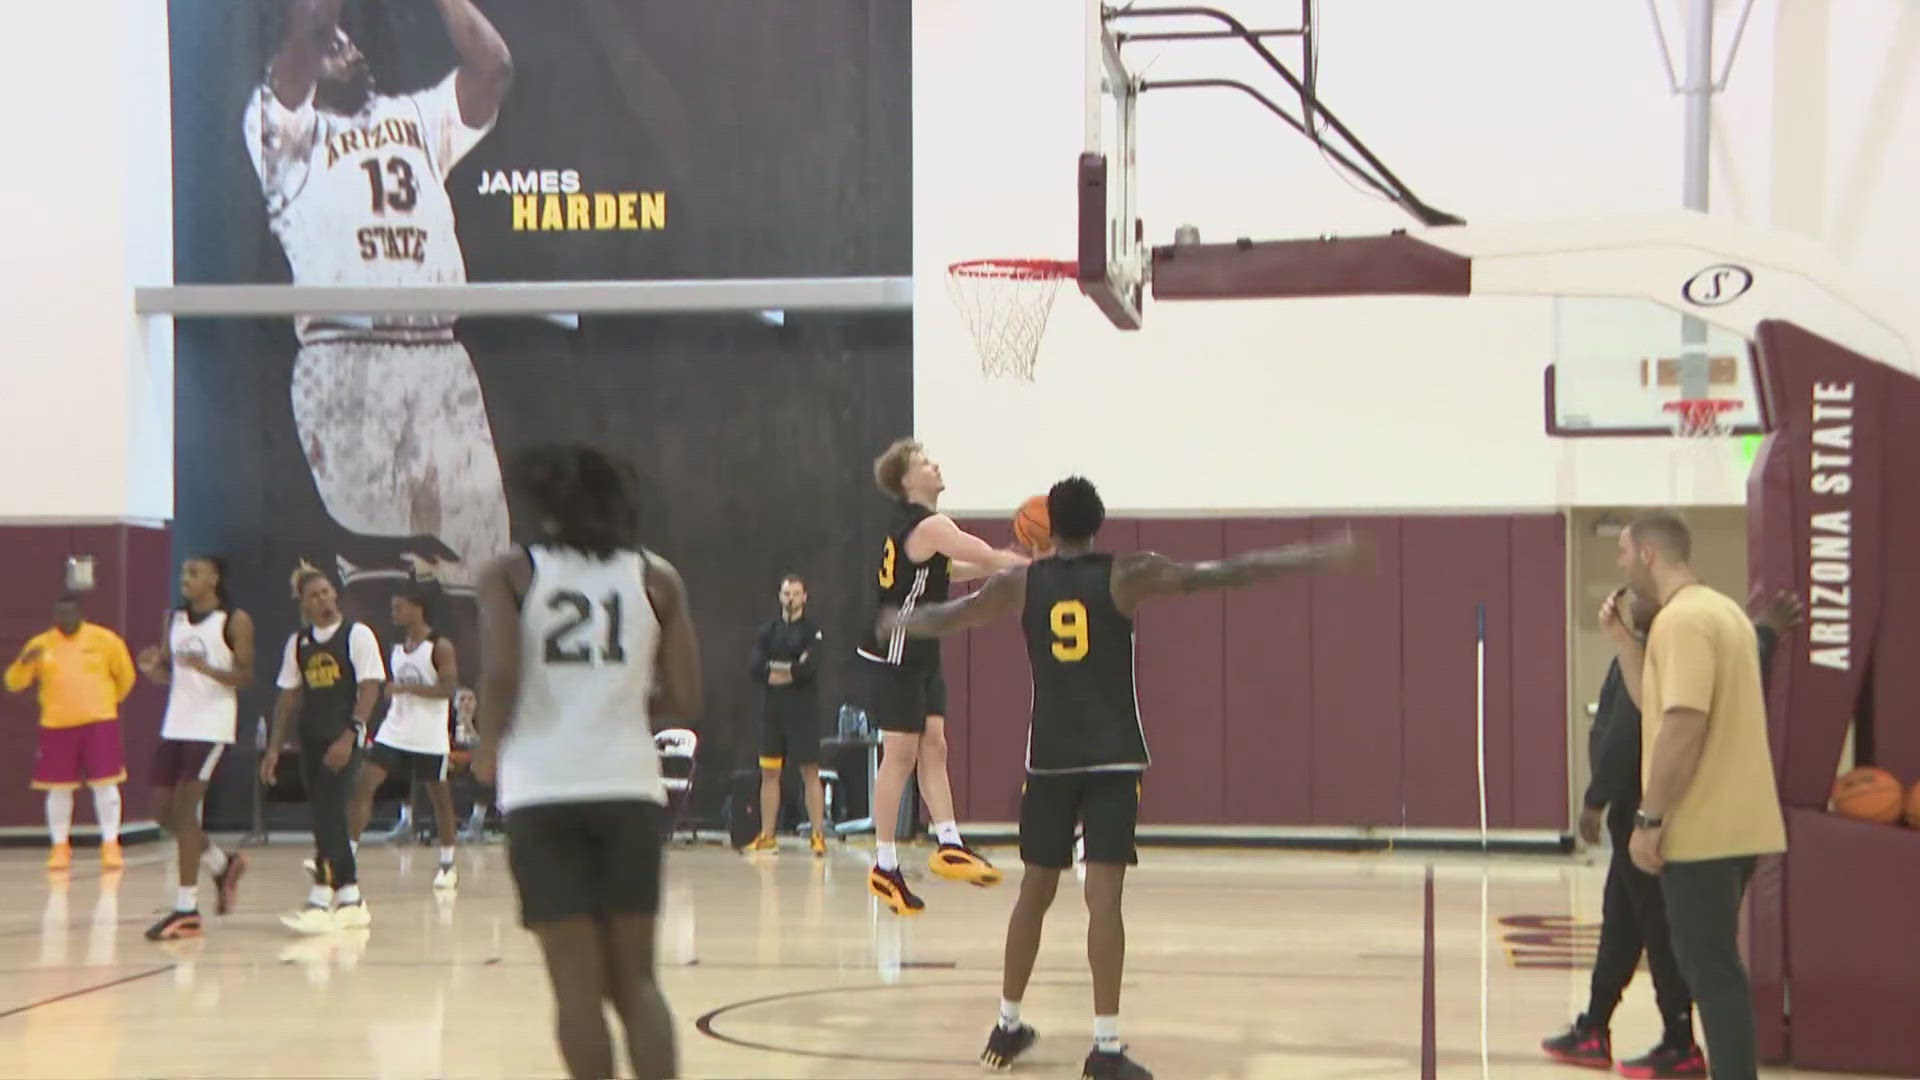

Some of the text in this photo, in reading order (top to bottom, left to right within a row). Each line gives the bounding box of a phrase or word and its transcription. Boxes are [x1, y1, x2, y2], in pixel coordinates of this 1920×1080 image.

[326, 118, 424, 168] ARIZON
[360, 155, 418, 217] 13
[478, 169, 580, 196] JAMES
[512, 192, 666, 231] HARDEN
[358, 226, 428, 264] STATE
[1809, 380, 1855, 671] ARIZONA STATE
[544, 588, 626, 662] 21
[1050, 599, 1089, 662] 9
